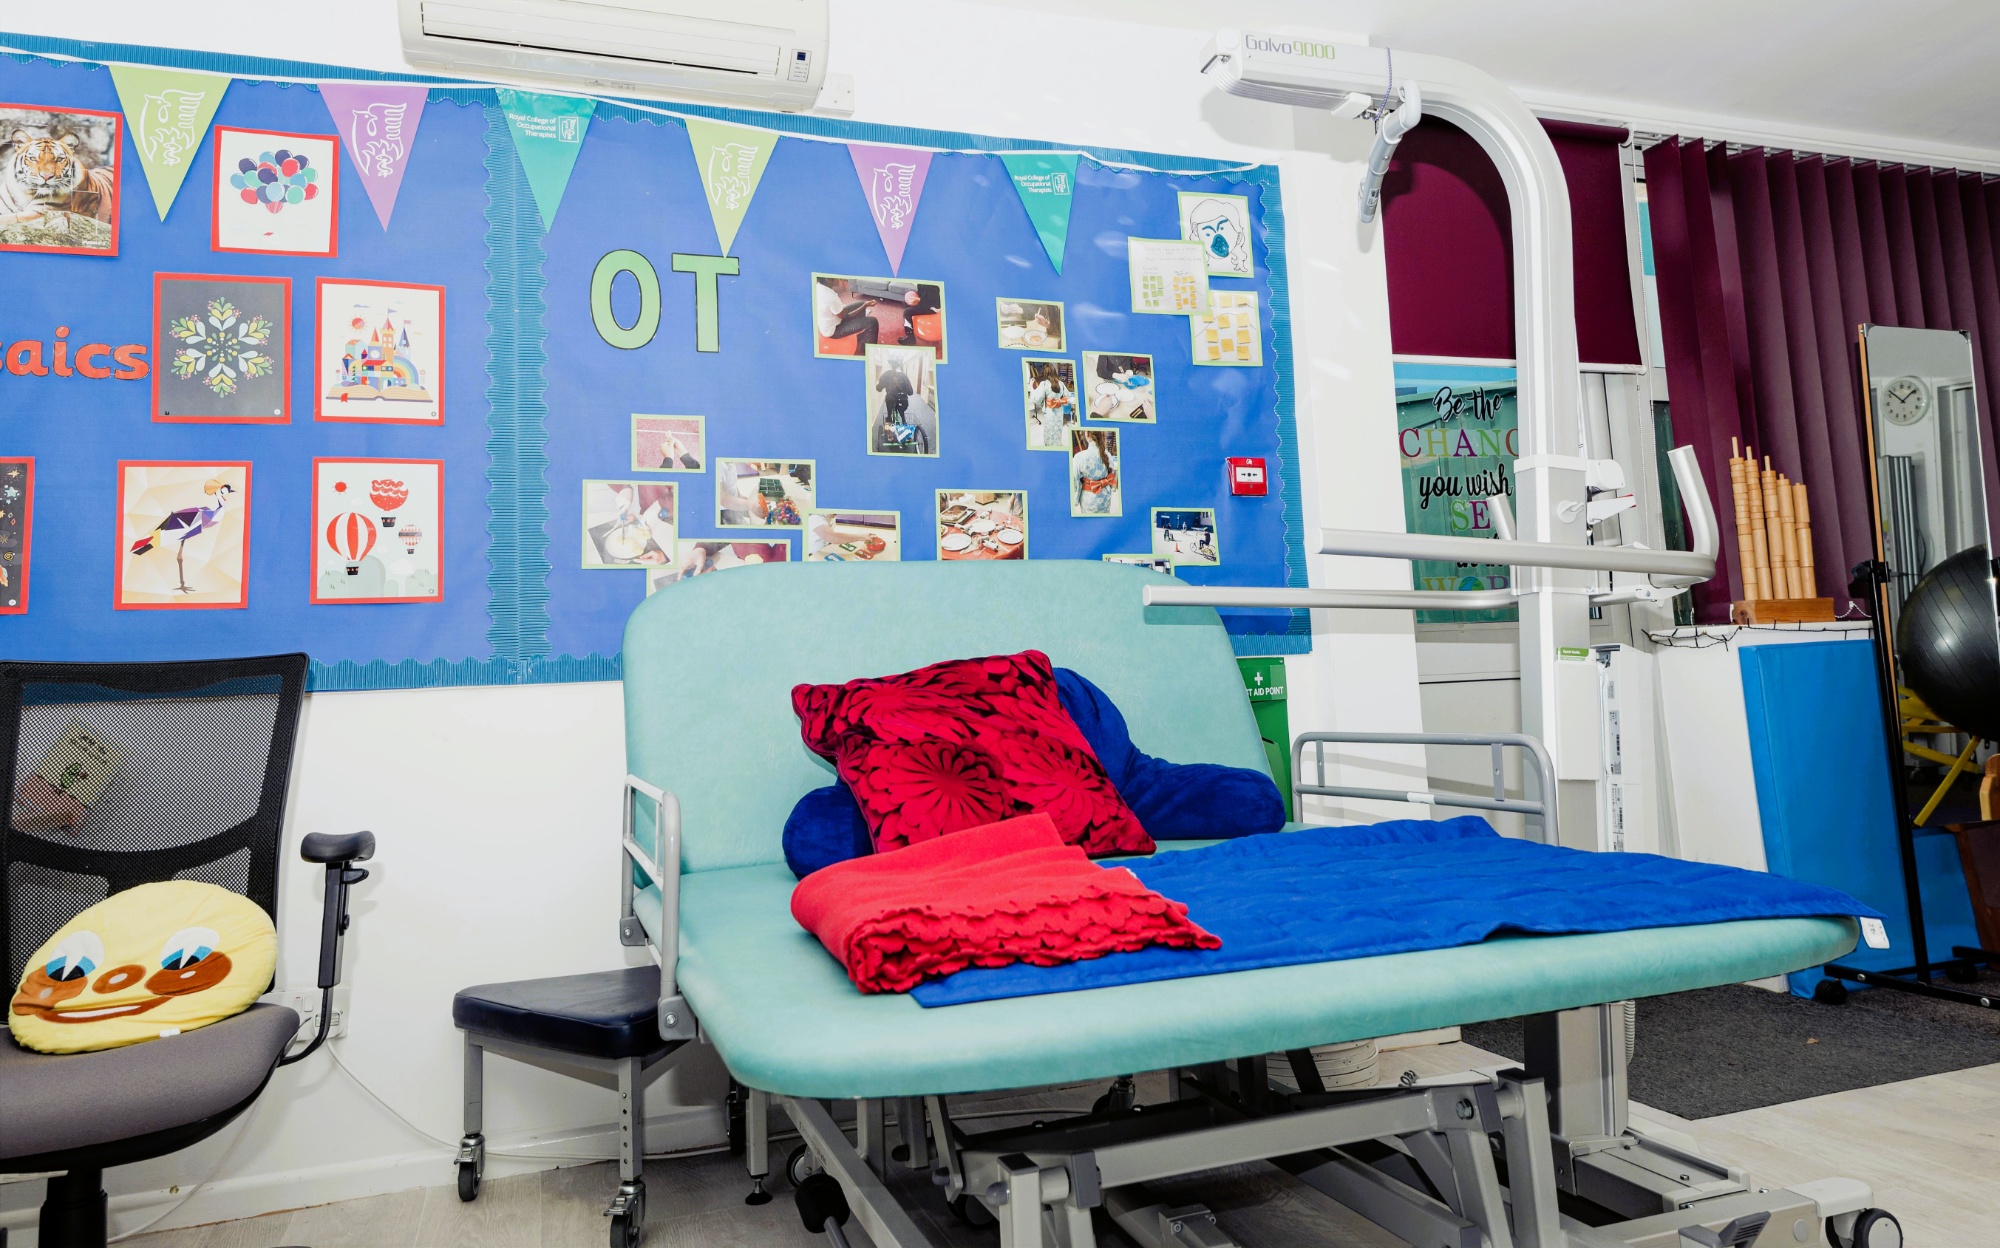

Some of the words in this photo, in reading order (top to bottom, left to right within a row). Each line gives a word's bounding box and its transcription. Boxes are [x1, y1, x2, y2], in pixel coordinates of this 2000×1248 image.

[509, 113, 526, 121] Royal
[526, 115, 549, 125] College
[516, 121, 557, 132] Occupational
[525, 129, 557, 139] Therapists
[1014, 174, 1027, 182] Royal
[1027, 174, 1045, 182] College
[590, 249, 740, 353] OT
[0, 325, 150, 380] aics
[1433, 386, 1465, 421] Be
[1465, 386, 1503, 421] the
[1419, 476, 1463, 510] you
[1466, 463, 1513, 497] wish
[1451, 499, 1491, 531] SE
[1253, 688, 1265, 696] AID
[1265, 686, 1284, 696] POINT
